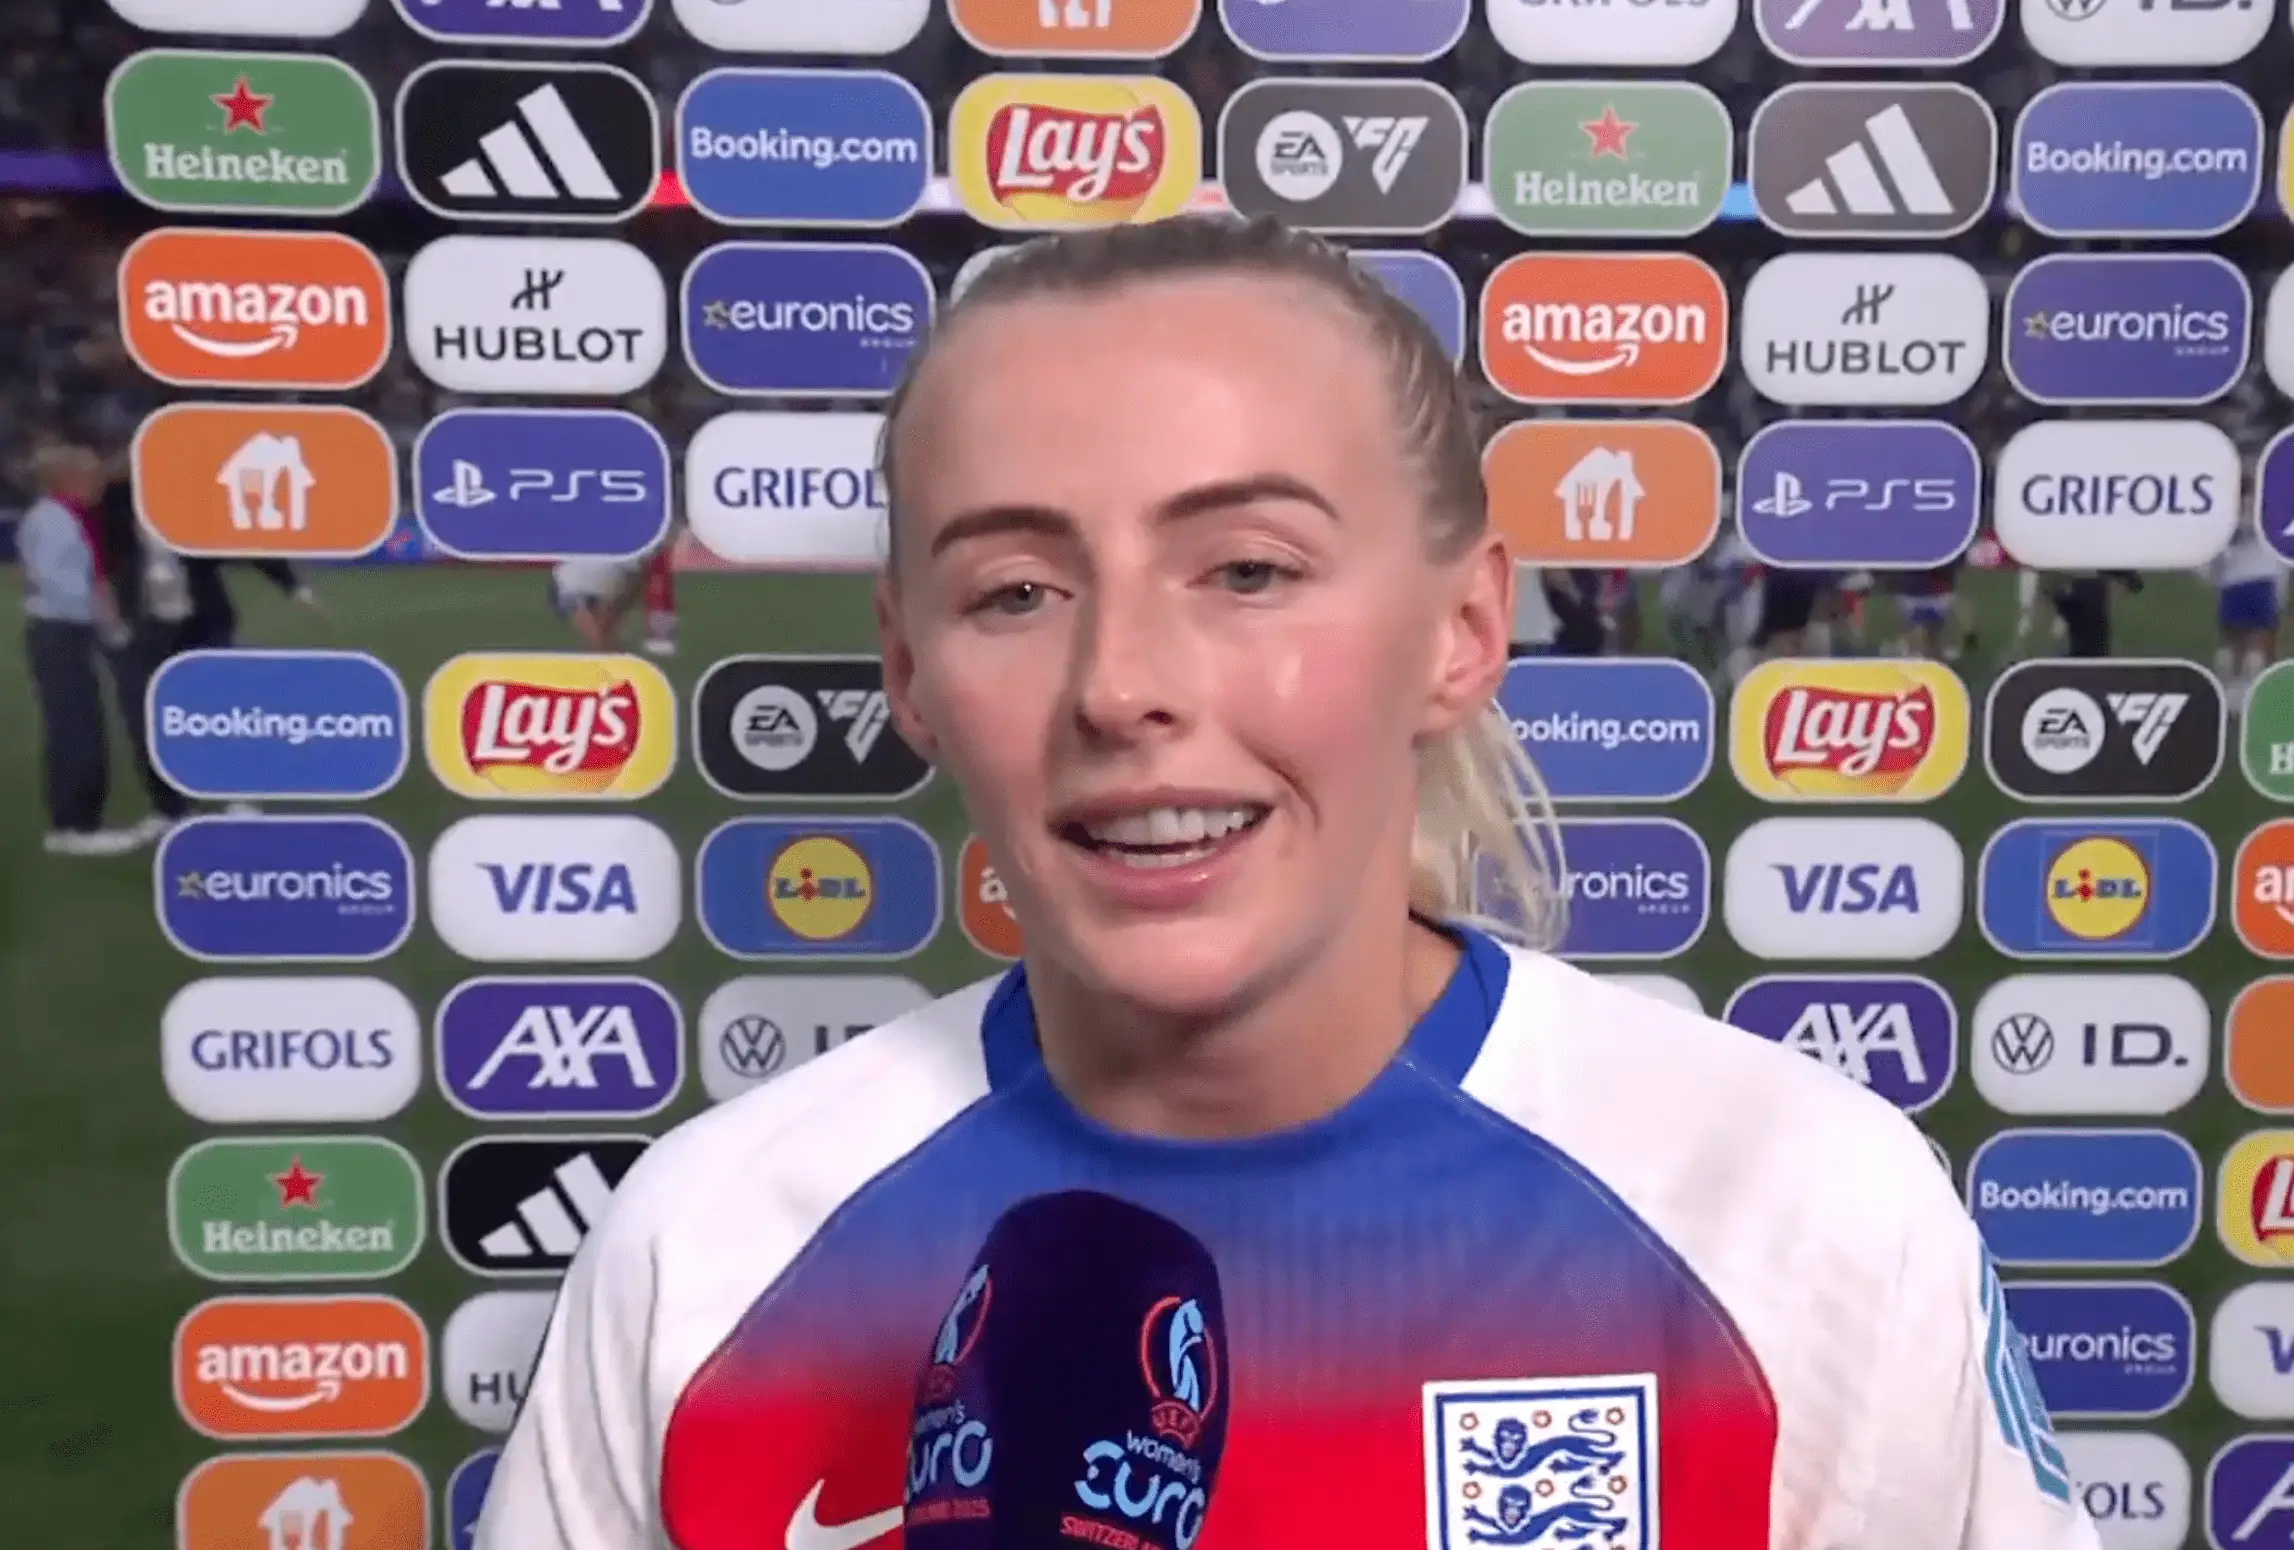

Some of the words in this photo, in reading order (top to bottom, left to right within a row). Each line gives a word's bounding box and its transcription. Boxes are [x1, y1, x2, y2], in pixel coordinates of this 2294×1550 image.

[143, 143, 350, 185] Heineken
[690, 127, 919, 168] Booking.com
[997, 104, 1155, 202] Lay's
[1273, 131, 1327, 159] EA
[2027, 142, 2248, 180] Booking.com
[1515, 170, 1701, 207] Heineken
[144, 279, 368, 327] amazon
[729, 293, 914, 333] euronics
[1503, 303, 1706, 343] amazon
[2050, 303, 2229, 342] euronics
[433, 325, 644, 363] HUBLOT
[1767, 340, 1967, 375] HUBLOT
[509, 468, 647, 503] PS5
[714, 466, 886, 509] GRIFOL
[1826, 478, 1956, 512] PS5
[2022, 473, 2214, 516] GRIFOLS
[162, 705, 394, 745] Booking.com
[473, 684, 632, 774] Lay's
[748, 705, 800, 731] EA
[1512, 711, 1700, 749] ooking.com
[1775, 690, 1927, 775] Lay's
[2041, 709, 2088, 734] EA
[204, 862, 393, 900] euronics
[473, 862, 638, 914] VISA
[1568, 863, 1690, 900] ronics
[1768, 863, 1920, 914] VISA
[191, 1028, 394, 1070] GRIFOLS
[467, 1005, 657, 1090] AXA
[1782, 1002, 1927, 1083] AXA
[2081, 1022, 2189, 1067] ID.
[1980, 1180, 2188, 1216] Booking.com
[203, 1219, 395, 1254] Heineken
[196, 1341, 408, 1381] amazon
